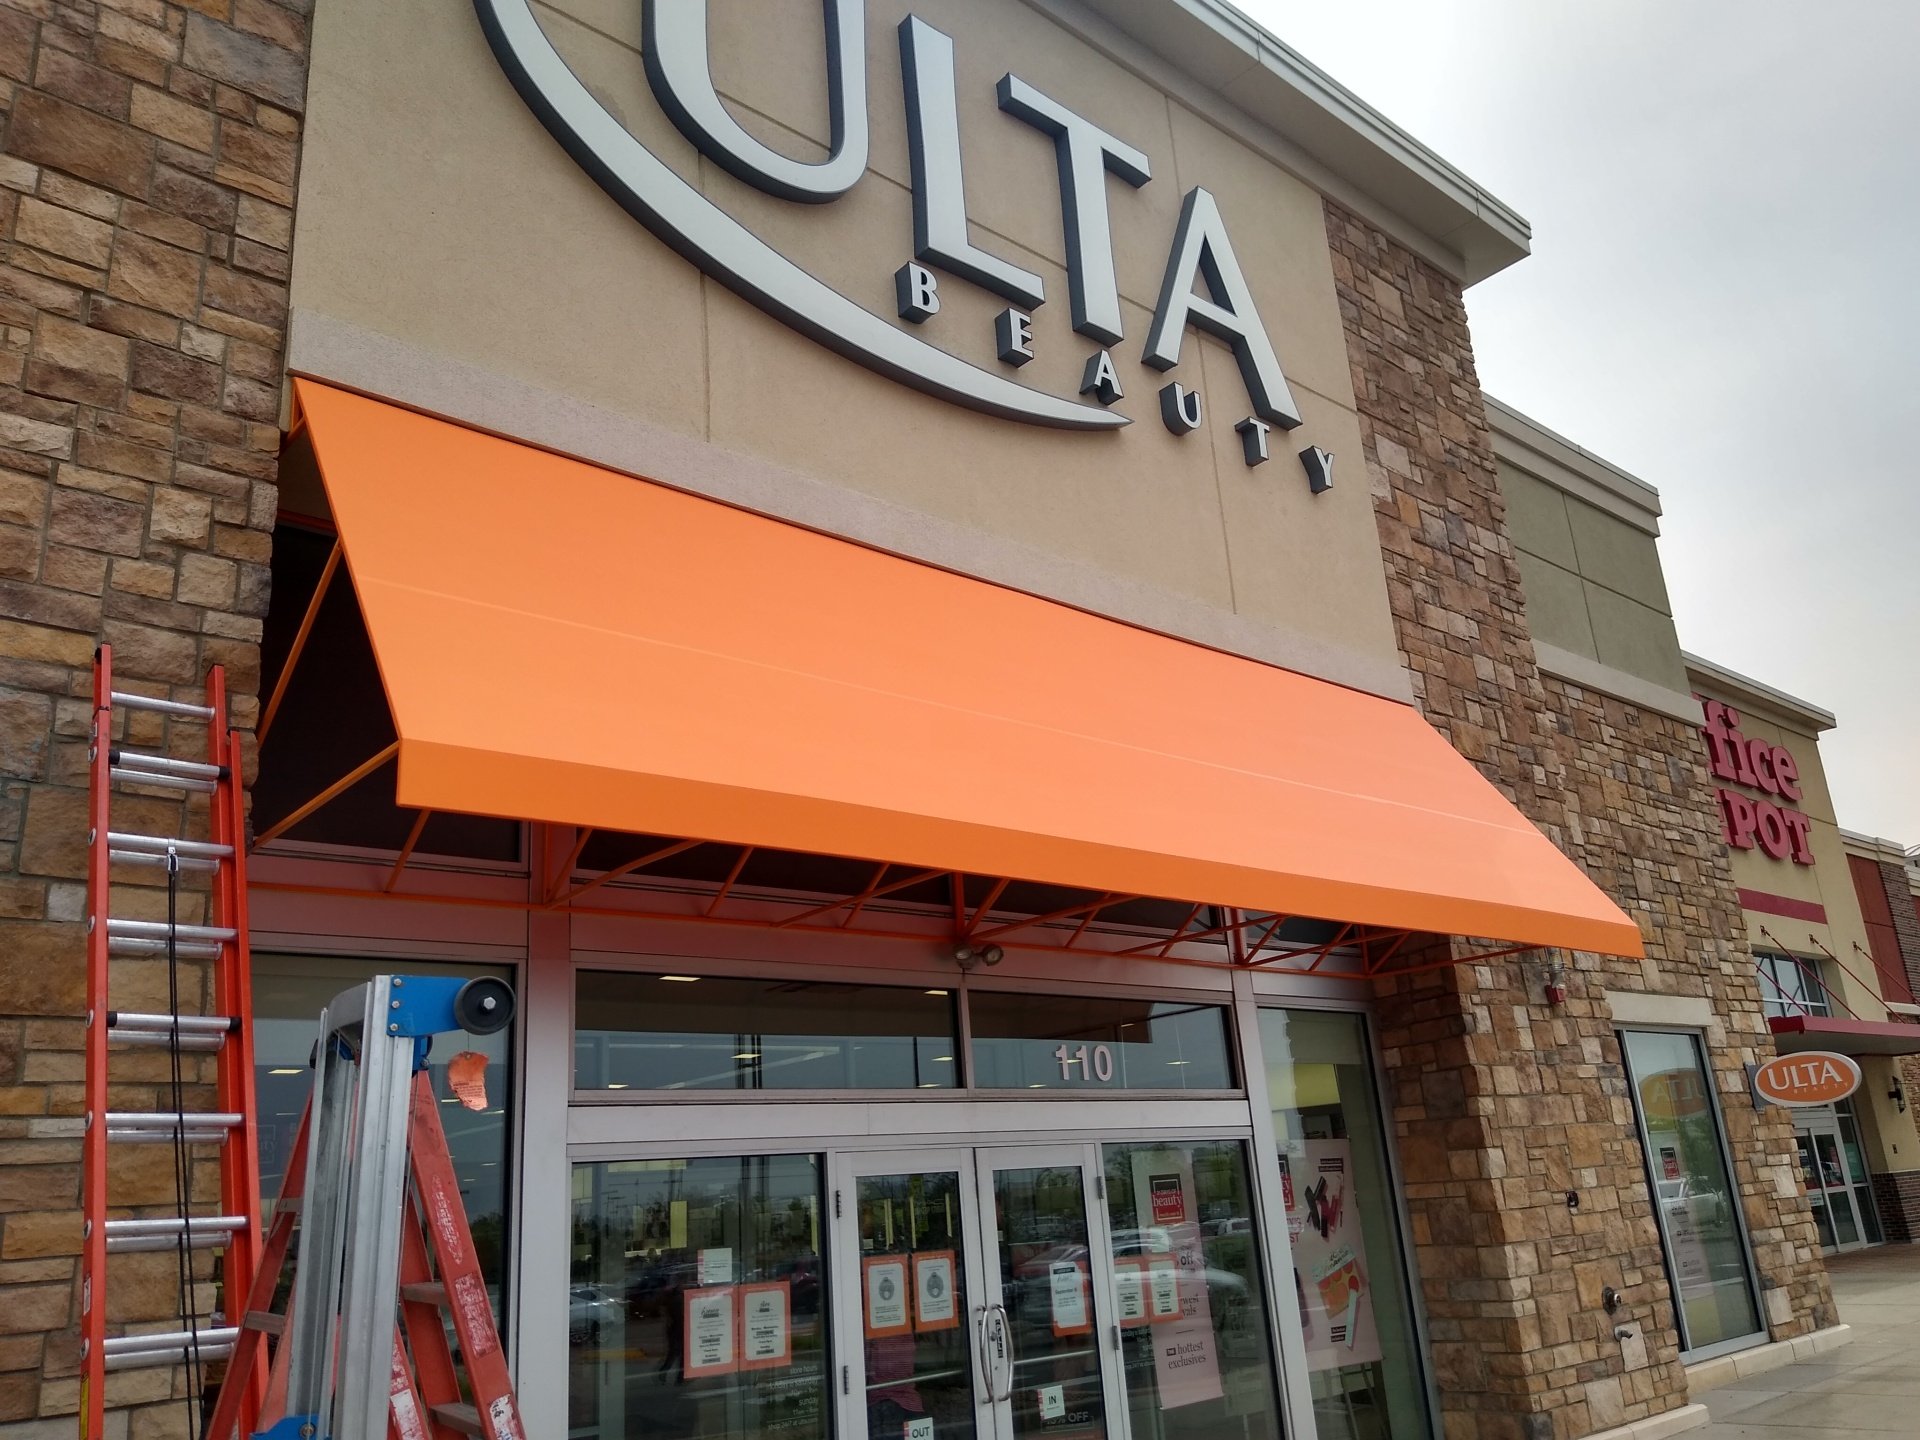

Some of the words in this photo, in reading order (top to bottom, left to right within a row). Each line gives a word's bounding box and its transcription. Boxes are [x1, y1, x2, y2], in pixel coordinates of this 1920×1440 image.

[643, 0, 1302, 430] ULTA
[895, 262, 1334, 494] BEAUTY
[1693, 693, 1803, 802] fice
[1714, 787, 1816, 867] POT
[1055, 1044, 1114, 1082] 110
[1767, 1060, 1844, 1091] ULTA
[1793, 1081, 1850, 1095] BEAUTY
[1152, 1194, 1183, 1208] beauty
[1177, 1342, 1204, 1355] hottest
[1168, 1354, 1207, 1369] exclusives
[1048, 1394, 1057, 1405] IN
[1068, 1411, 1089, 1422] OFF
[911, 1427, 930, 1438] OUT
